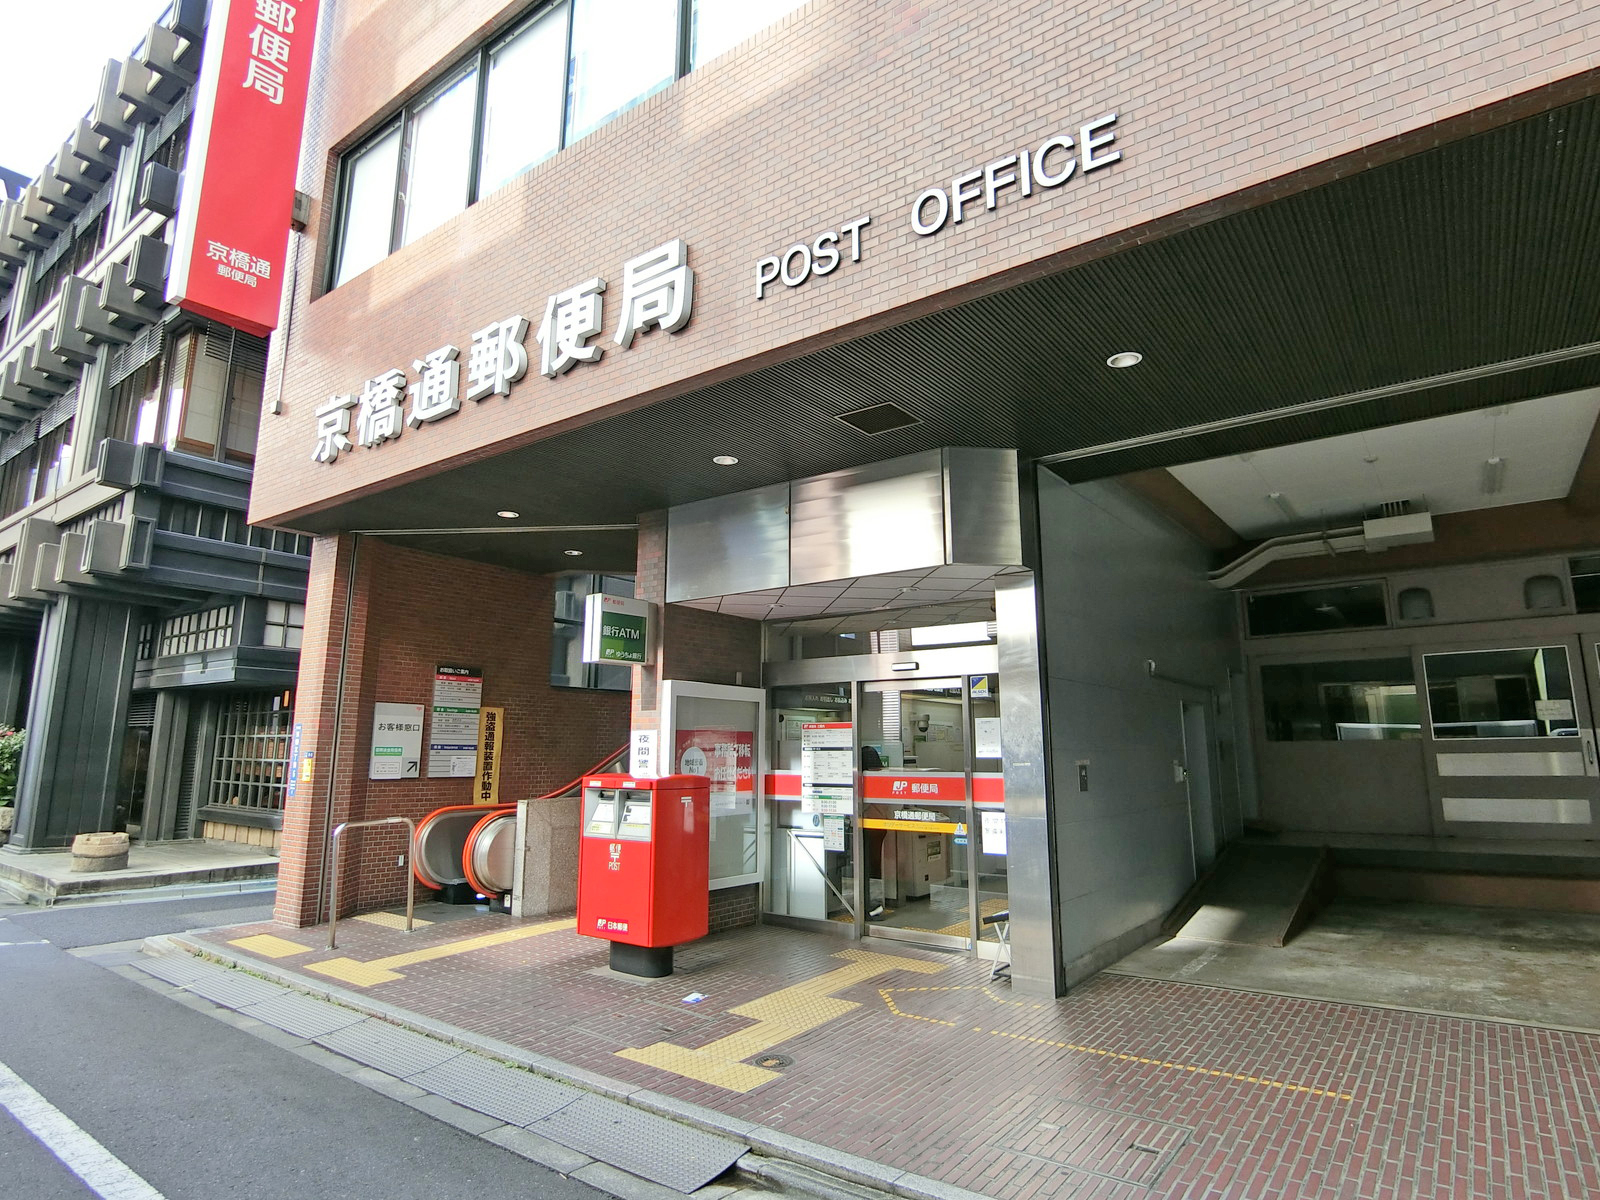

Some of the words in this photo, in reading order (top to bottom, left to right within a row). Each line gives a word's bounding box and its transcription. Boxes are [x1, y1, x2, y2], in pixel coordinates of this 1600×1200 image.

[756, 216, 871, 300] POST
[911, 113, 1123, 236] OFFICE
[206, 240, 271, 279] 京橋通
[217, 264, 257, 288] 郵便局
[311, 238, 694, 464] 京橋通郵便局
[602, 625, 640, 640] 銀行ATM
[616, 651, 642, 660] ゆうちょ銀行
[378, 722, 421, 732] お客様窓口
[480, 711, 497, 801] 強盗通報装置作動中
[911, 783, 938, 794] 郵便局
[893, 810, 936, 821] 京橋通郵便局
[608, 843, 622, 854] 郵便
[608, 861, 621, 871] POST
[607, 920, 628, 932] 日本郵便
